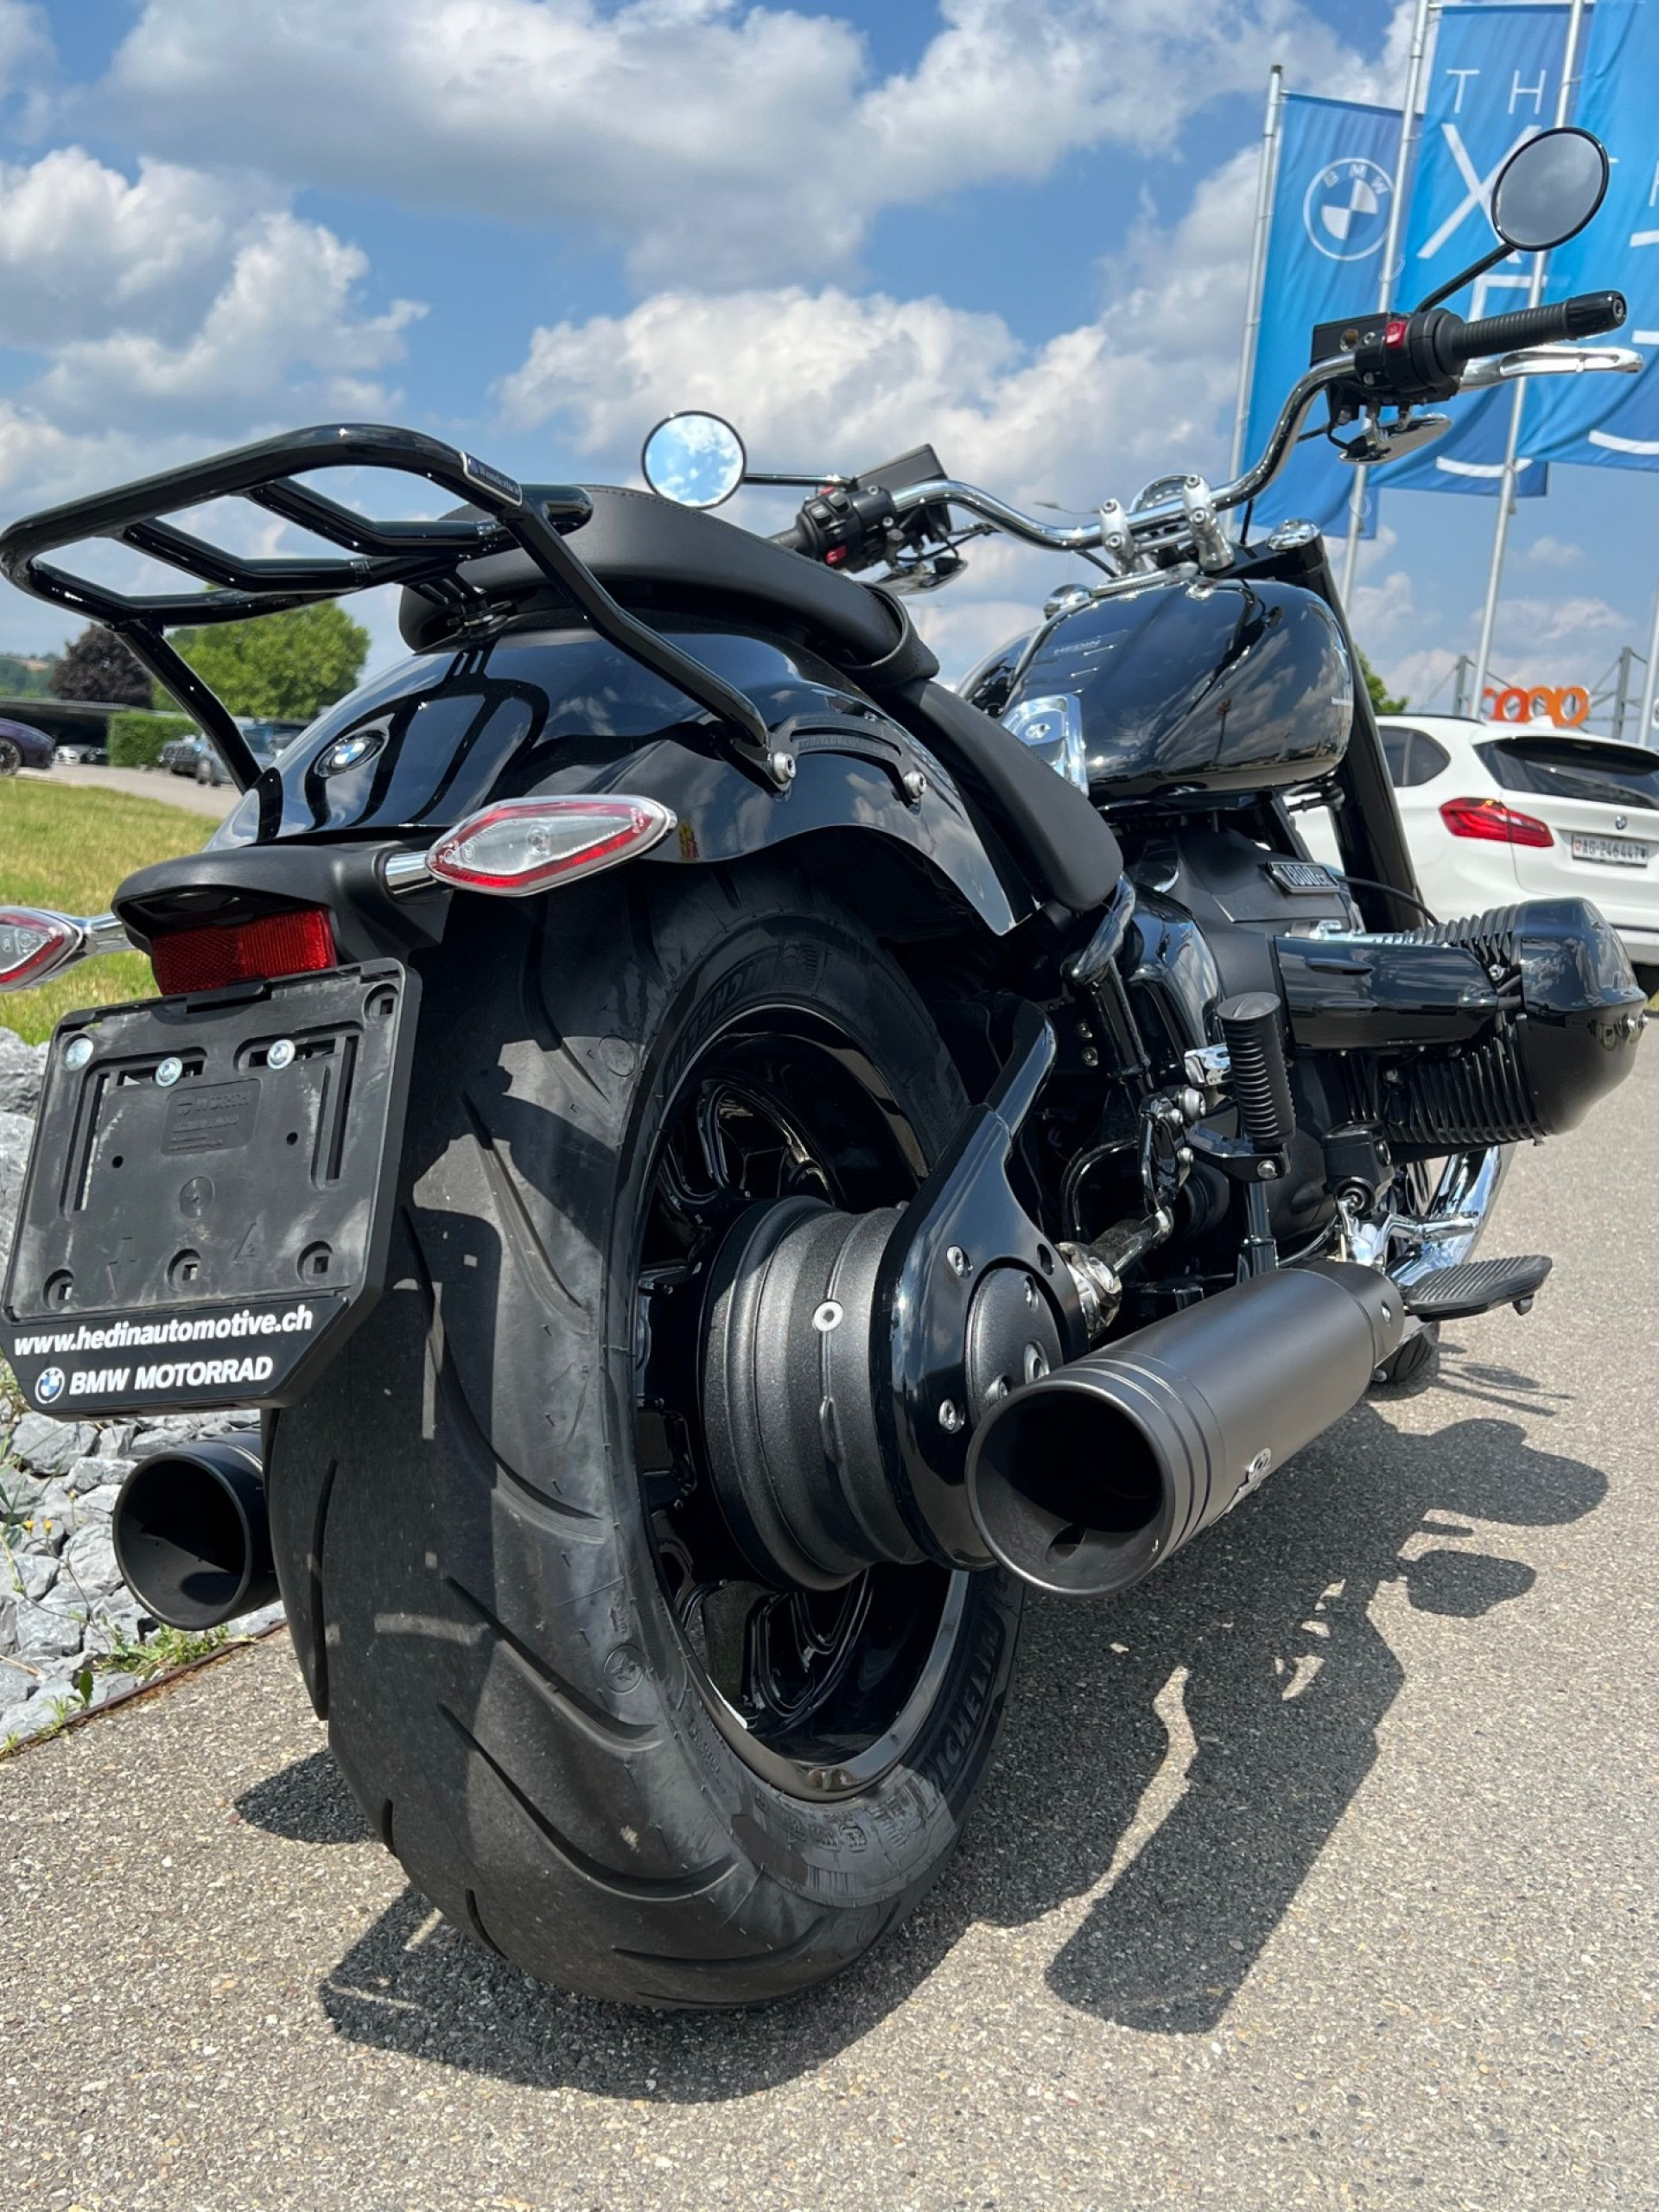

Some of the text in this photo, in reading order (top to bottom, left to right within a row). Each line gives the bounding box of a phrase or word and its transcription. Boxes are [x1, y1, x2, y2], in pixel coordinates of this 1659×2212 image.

[1323, 164, 1389, 194] BMW
[14, 1304, 314, 1357] www.hedinautomotive.ch
[68, 1368, 130, 1395] BMW
[134, 1356, 274, 1390] MOTORRAD
